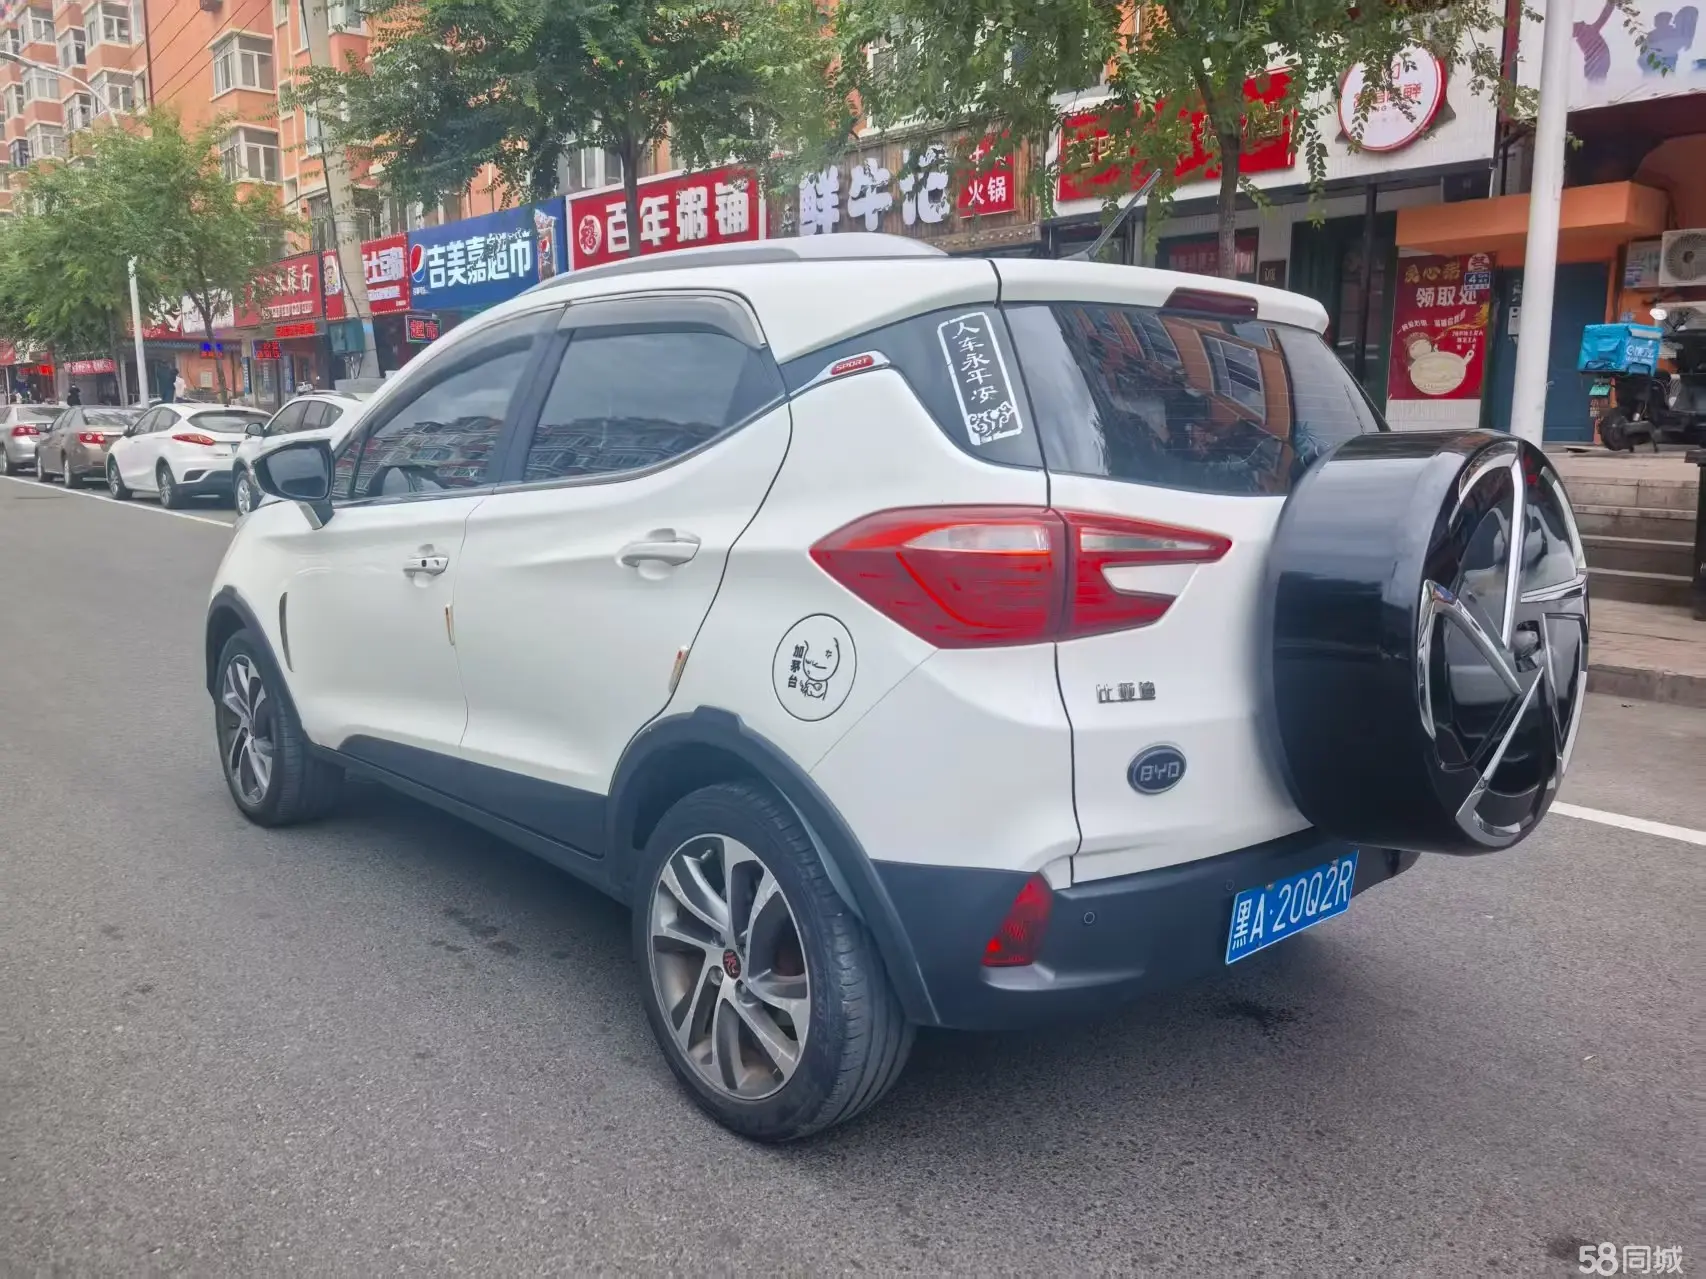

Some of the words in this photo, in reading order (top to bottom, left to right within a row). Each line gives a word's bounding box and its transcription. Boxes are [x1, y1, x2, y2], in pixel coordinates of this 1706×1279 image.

[968, 176, 1006, 205] 火锅
[605, 180, 749, 253] 百年粥铺
[1416, 286, 1477, 308] 领取处
[410, 320, 439, 339] 超市
[836, 357, 868, 371] SPORT
[1140, 761, 1180, 782] BYD
